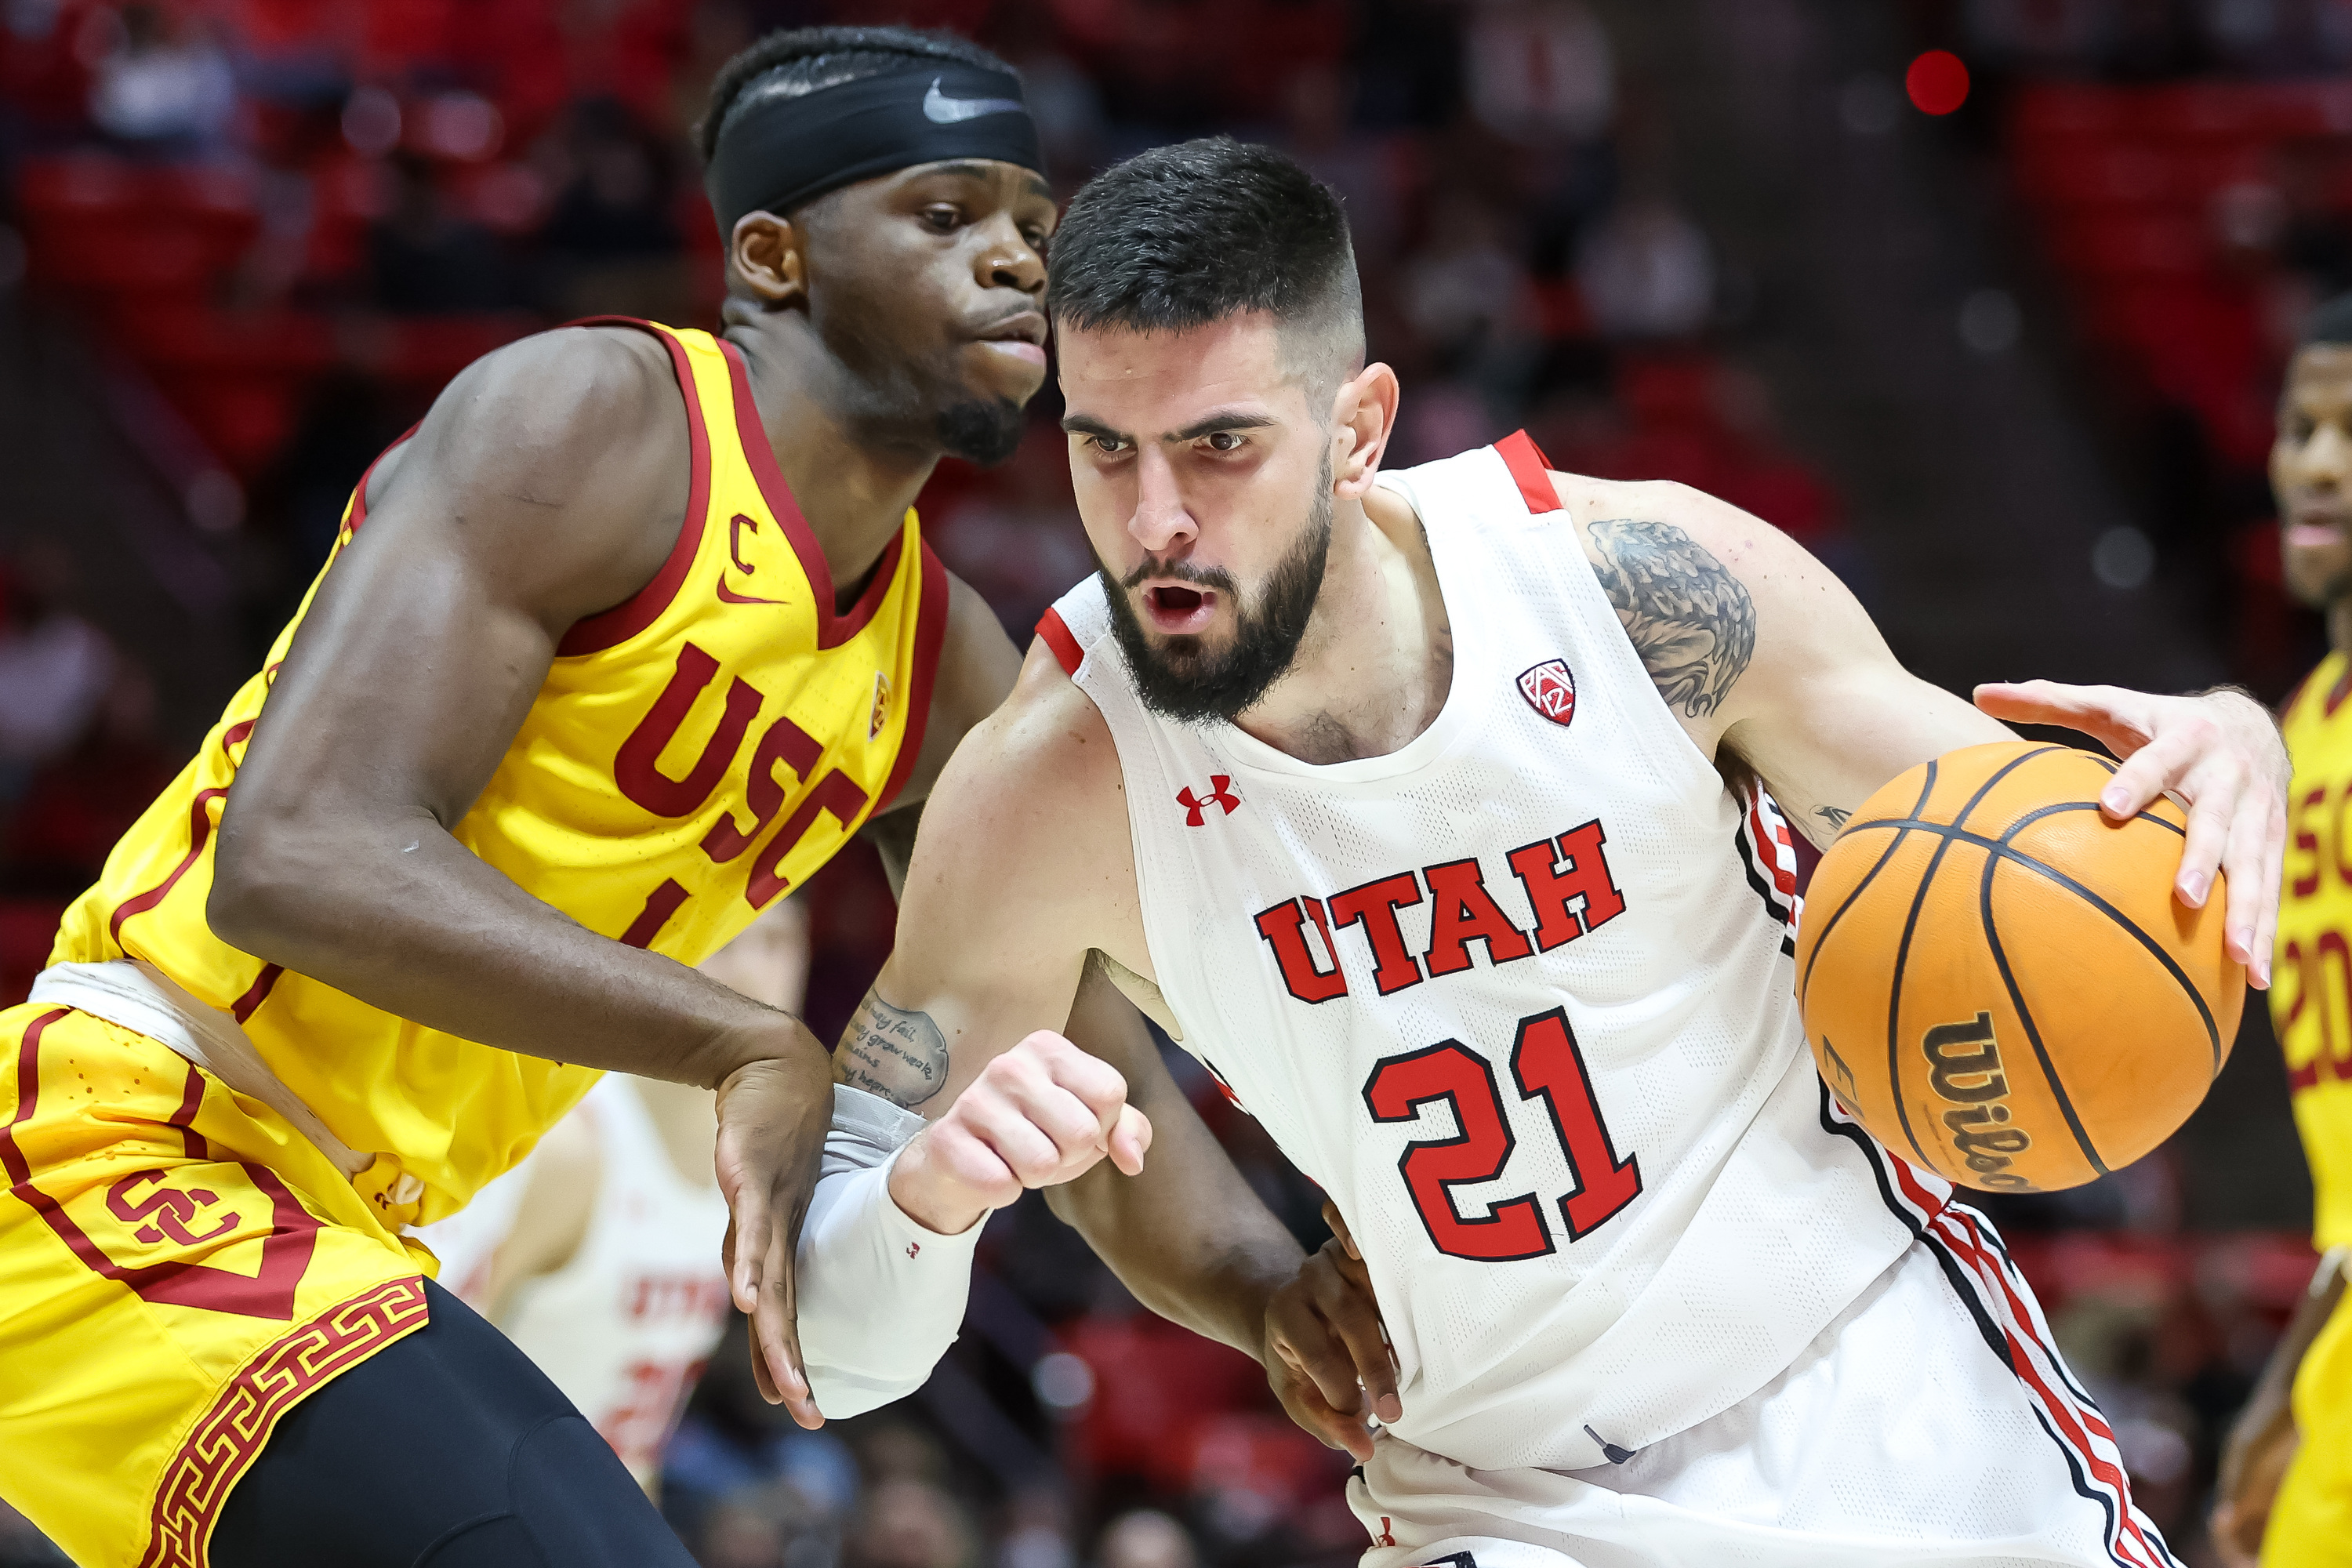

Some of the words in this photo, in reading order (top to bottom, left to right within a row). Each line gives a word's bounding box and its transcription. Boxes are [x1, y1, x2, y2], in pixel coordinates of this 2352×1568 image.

[614, 641, 868, 910] USC
[1254, 818, 1626, 1005] UTAH
[1362, 1005, 1642, 1262] 21
[1921, 1010, 2040, 1192] Wilso
[106, 1169, 241, 1246] SC
